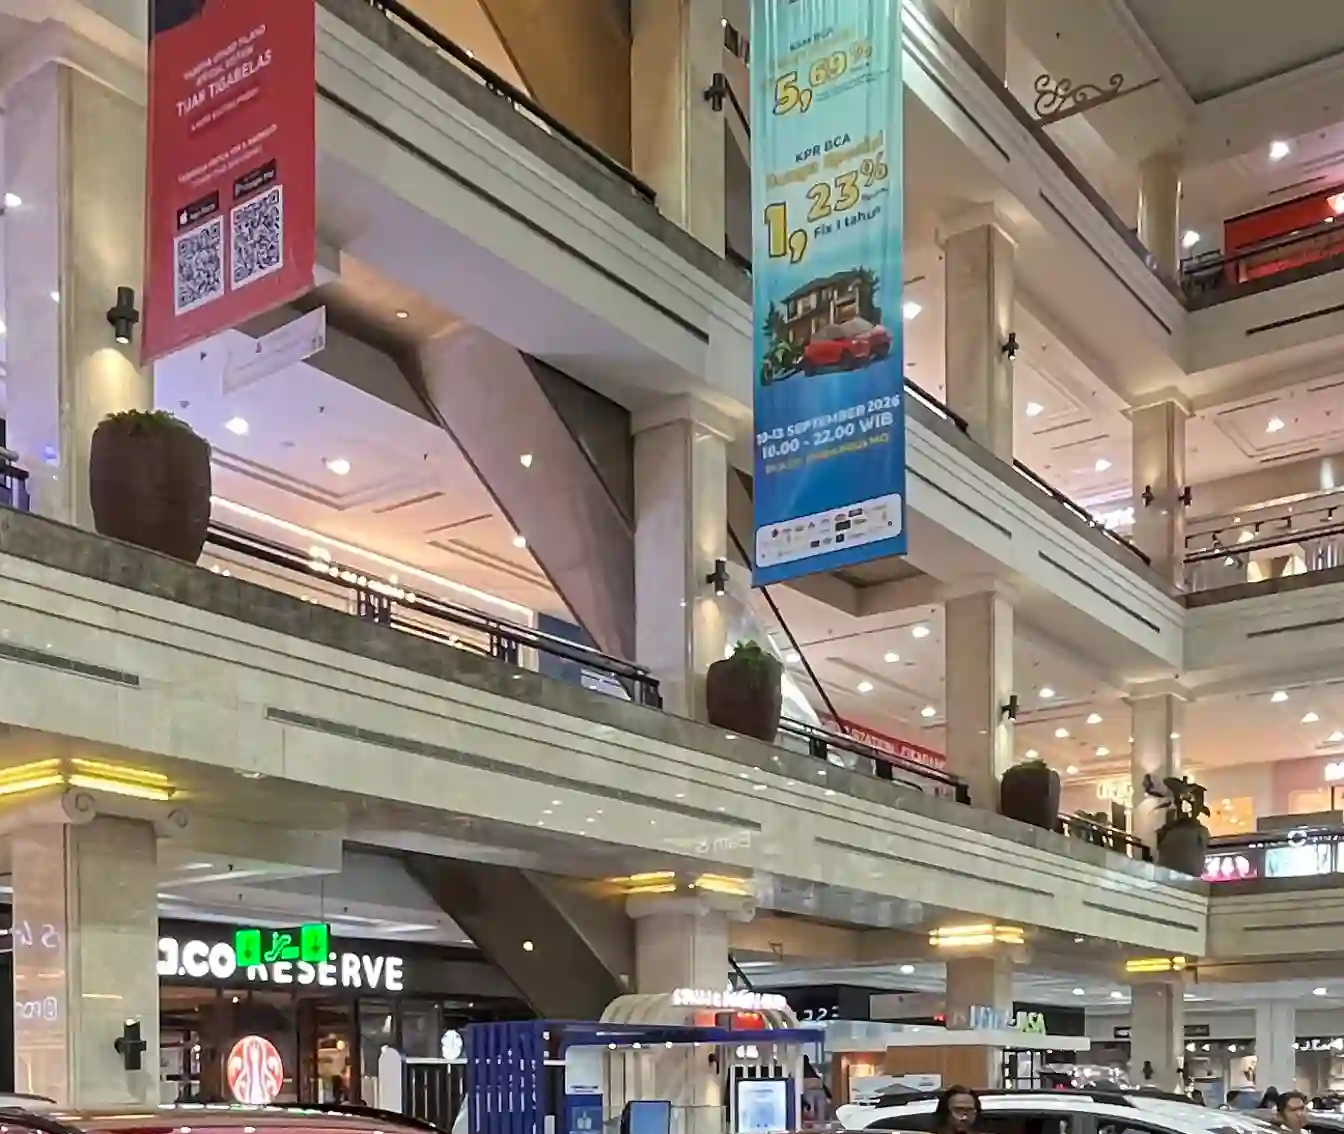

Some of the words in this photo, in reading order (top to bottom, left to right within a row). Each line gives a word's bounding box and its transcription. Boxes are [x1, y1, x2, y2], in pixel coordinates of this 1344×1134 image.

[175, 83, 207, 118] TUAN
[208, 48, 274, 99] TIGABELAS
[824, 132, 852, 153] BCA
[813, 222, 833, 239] Fix
[844, 205, 882, 228] tahun
[786, 404, 866, 438] SEPTEMBER
[867, 394, 901, 414] 2026
[812, 424, 855, 446] 22.00
[858, 411, 894, 434] WIB
